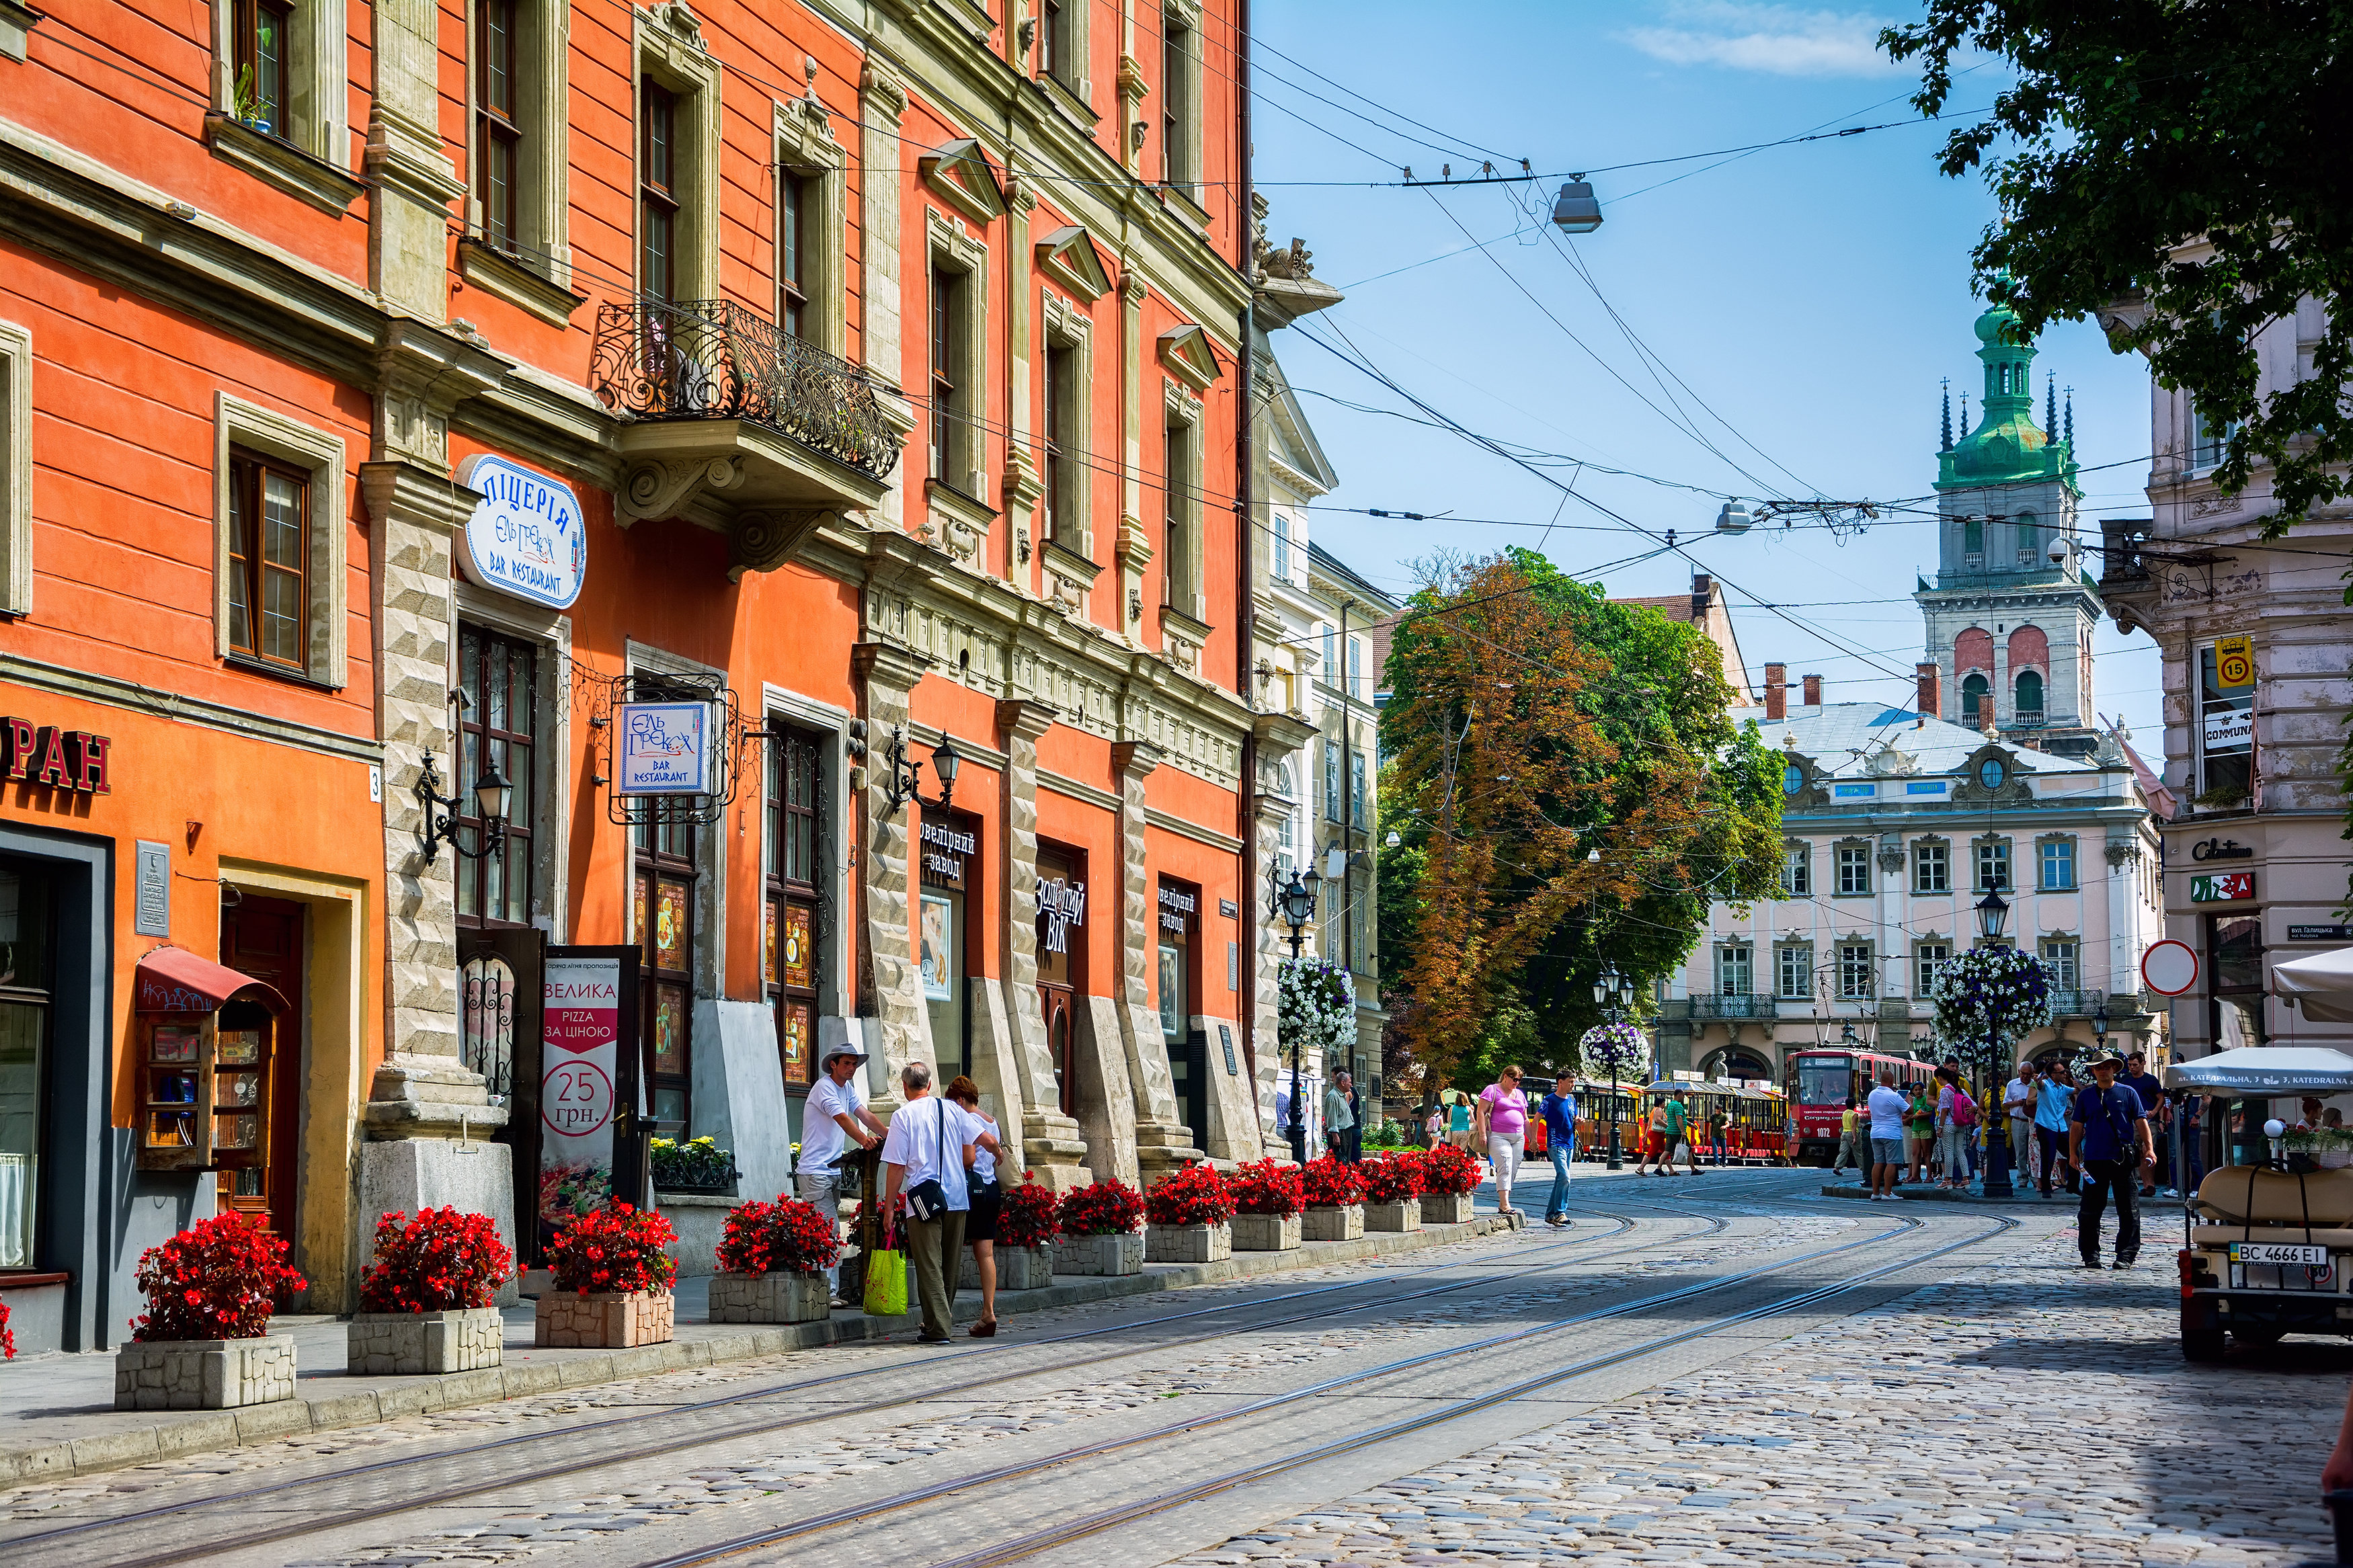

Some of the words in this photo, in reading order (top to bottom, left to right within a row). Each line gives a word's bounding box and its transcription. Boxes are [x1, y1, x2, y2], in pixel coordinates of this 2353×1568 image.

[483, 474, 570, 536] ПІЦЕРІЯ
[489, 550, 506, 576] BAR
[512, 559, 561, 595] RESTAURANT
[2227, 663, 2243, 676] 15
[0, 716, 111, 795] РАН
[653, 760, 670, 770] BAR
[372, 772, 378, 796] 3
[634, 771, 688, 783] RESTAURANT
[930, 854, 960, 881] завод
[1162, 913, 1184, 935] завод
[545, 983, 616, 999] ВЕЛИКА
[562, 1012, 594, 1022] PIZZA
[545, 1026, 562, 1037] ЗА
[565, 1026, 610, 1038] ЦІНОЮ
[557, 1071, 595, 1102] 25
[2190, 1074, 2252, 1083] КАТЕДРАЛЬНА,
[2293, 1077, 2348, 1085] KATEDRALNA
[555, 1107, 600, 1128] грн.
[1817, 1128, 1831, 1138] 1072
[2240, 1246, 2260, 1260] BC
[2265, 1247, 2298, 1262] 4666
[2303, 1248, 2319, 1262] EI
